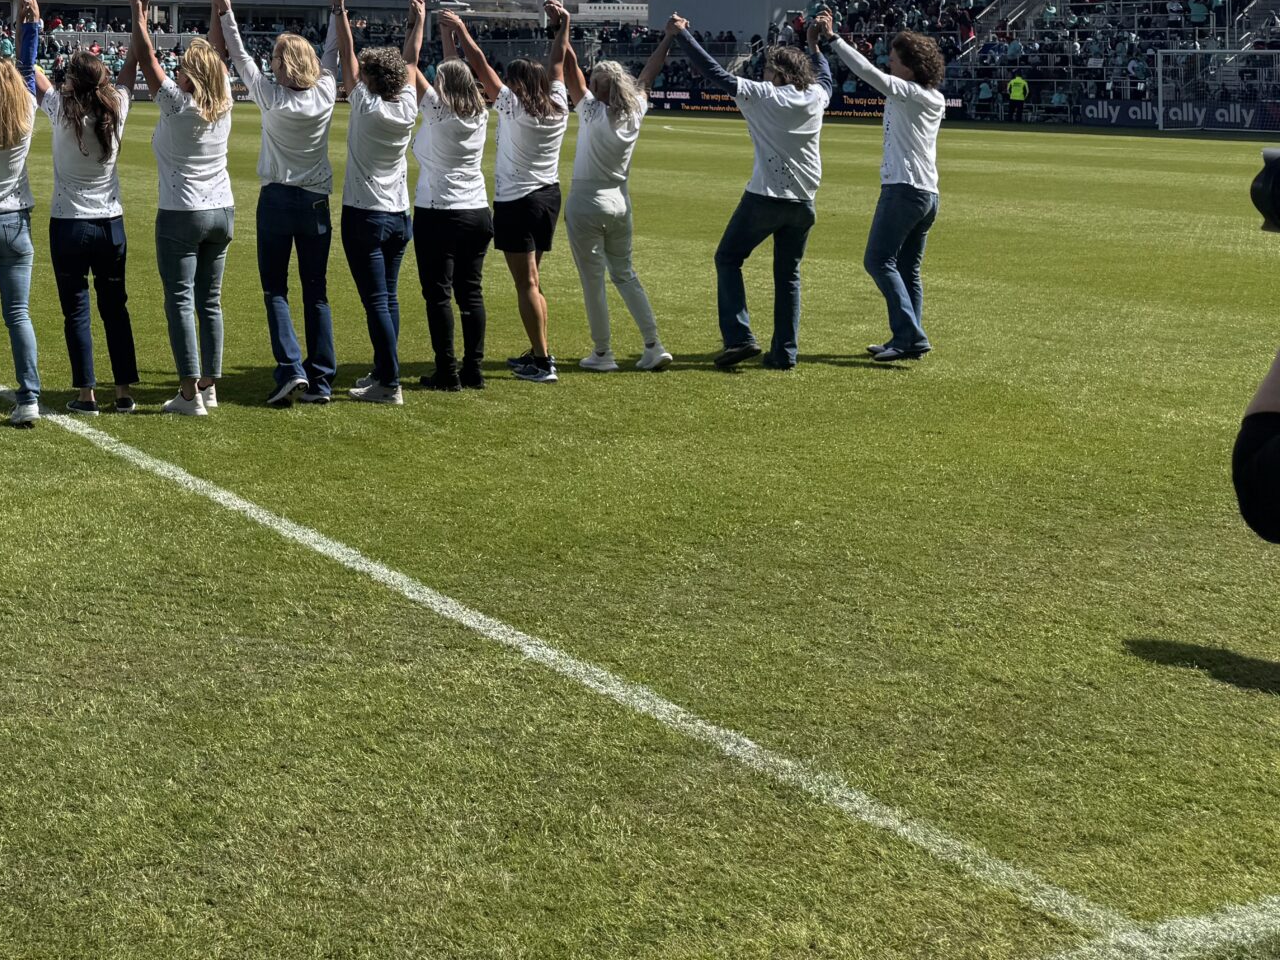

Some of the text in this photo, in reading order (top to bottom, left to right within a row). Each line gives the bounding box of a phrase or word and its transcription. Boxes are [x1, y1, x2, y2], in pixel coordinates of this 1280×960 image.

[843, 95, 855, 105] The
[855, 98, 868, 107] way
[1085, 100, 1120, 123] ally
[1169, 102, 1206, 126] ally
[1215, 103, 1255, 128] ally
